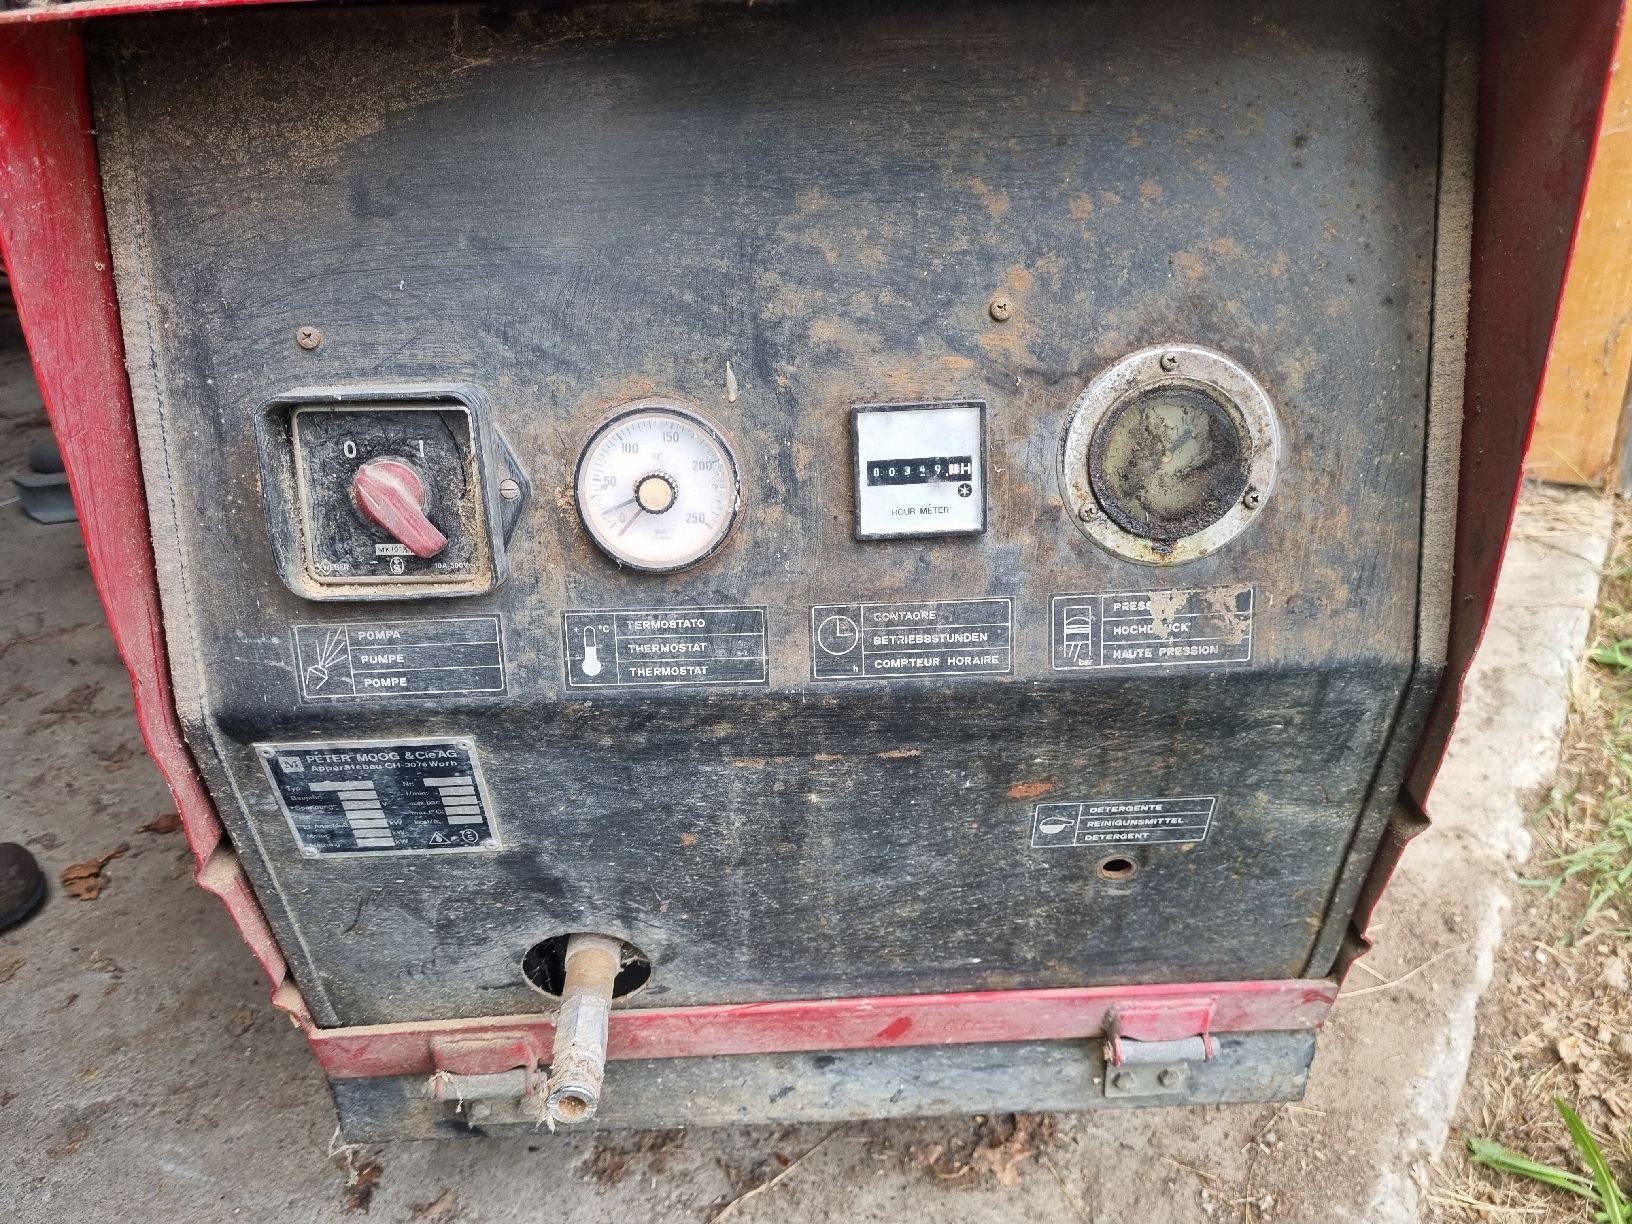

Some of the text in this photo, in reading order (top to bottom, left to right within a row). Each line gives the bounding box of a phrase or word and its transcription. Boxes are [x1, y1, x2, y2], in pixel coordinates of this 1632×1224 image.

[662, 431, 680, 443] 150
[343, 440, 357, 459] 0
[621, 442, 639, 454] 100
[692, 460, 713, 472] 200
[603, 476, 617, 488] 50
[891, 507, 916, 517] HOUR
[618, 514, 626, 524] 0
[686, 513, 706, 524] 250
[627, 618, 706, 631] TERMOSTATO
[1113, 622, 1190, 636] HOCHDUCK
[358, 630, 401, 641] POMPA
[873, 632, 988, 645] BETRIEBSSTUNDEN
[628, 642, 707, 654] THERMOSTAT
[1113, 645, 1219, 660] HAUTE PRESSION
[361, 653, 405, 664] PUMPE
[874, 655, 1000, 669] COMPTEUR HORAIRE
[629, 666, 709, 677] THERMOSTAT
[364, 677, 408, 688] POMPE
[305, 754, 351, 763] PETER
[356, 752, 400, 762] MOOG
[404, 751, 415, 760] &
[437, 749, 458, 758] AG
[1089, 804, 1163, 814] DETERGENTE
[1086, 817, 1184, 828] REINIGUNSMITTEL
[1084, 832, 1150, 841] DETERGENT
